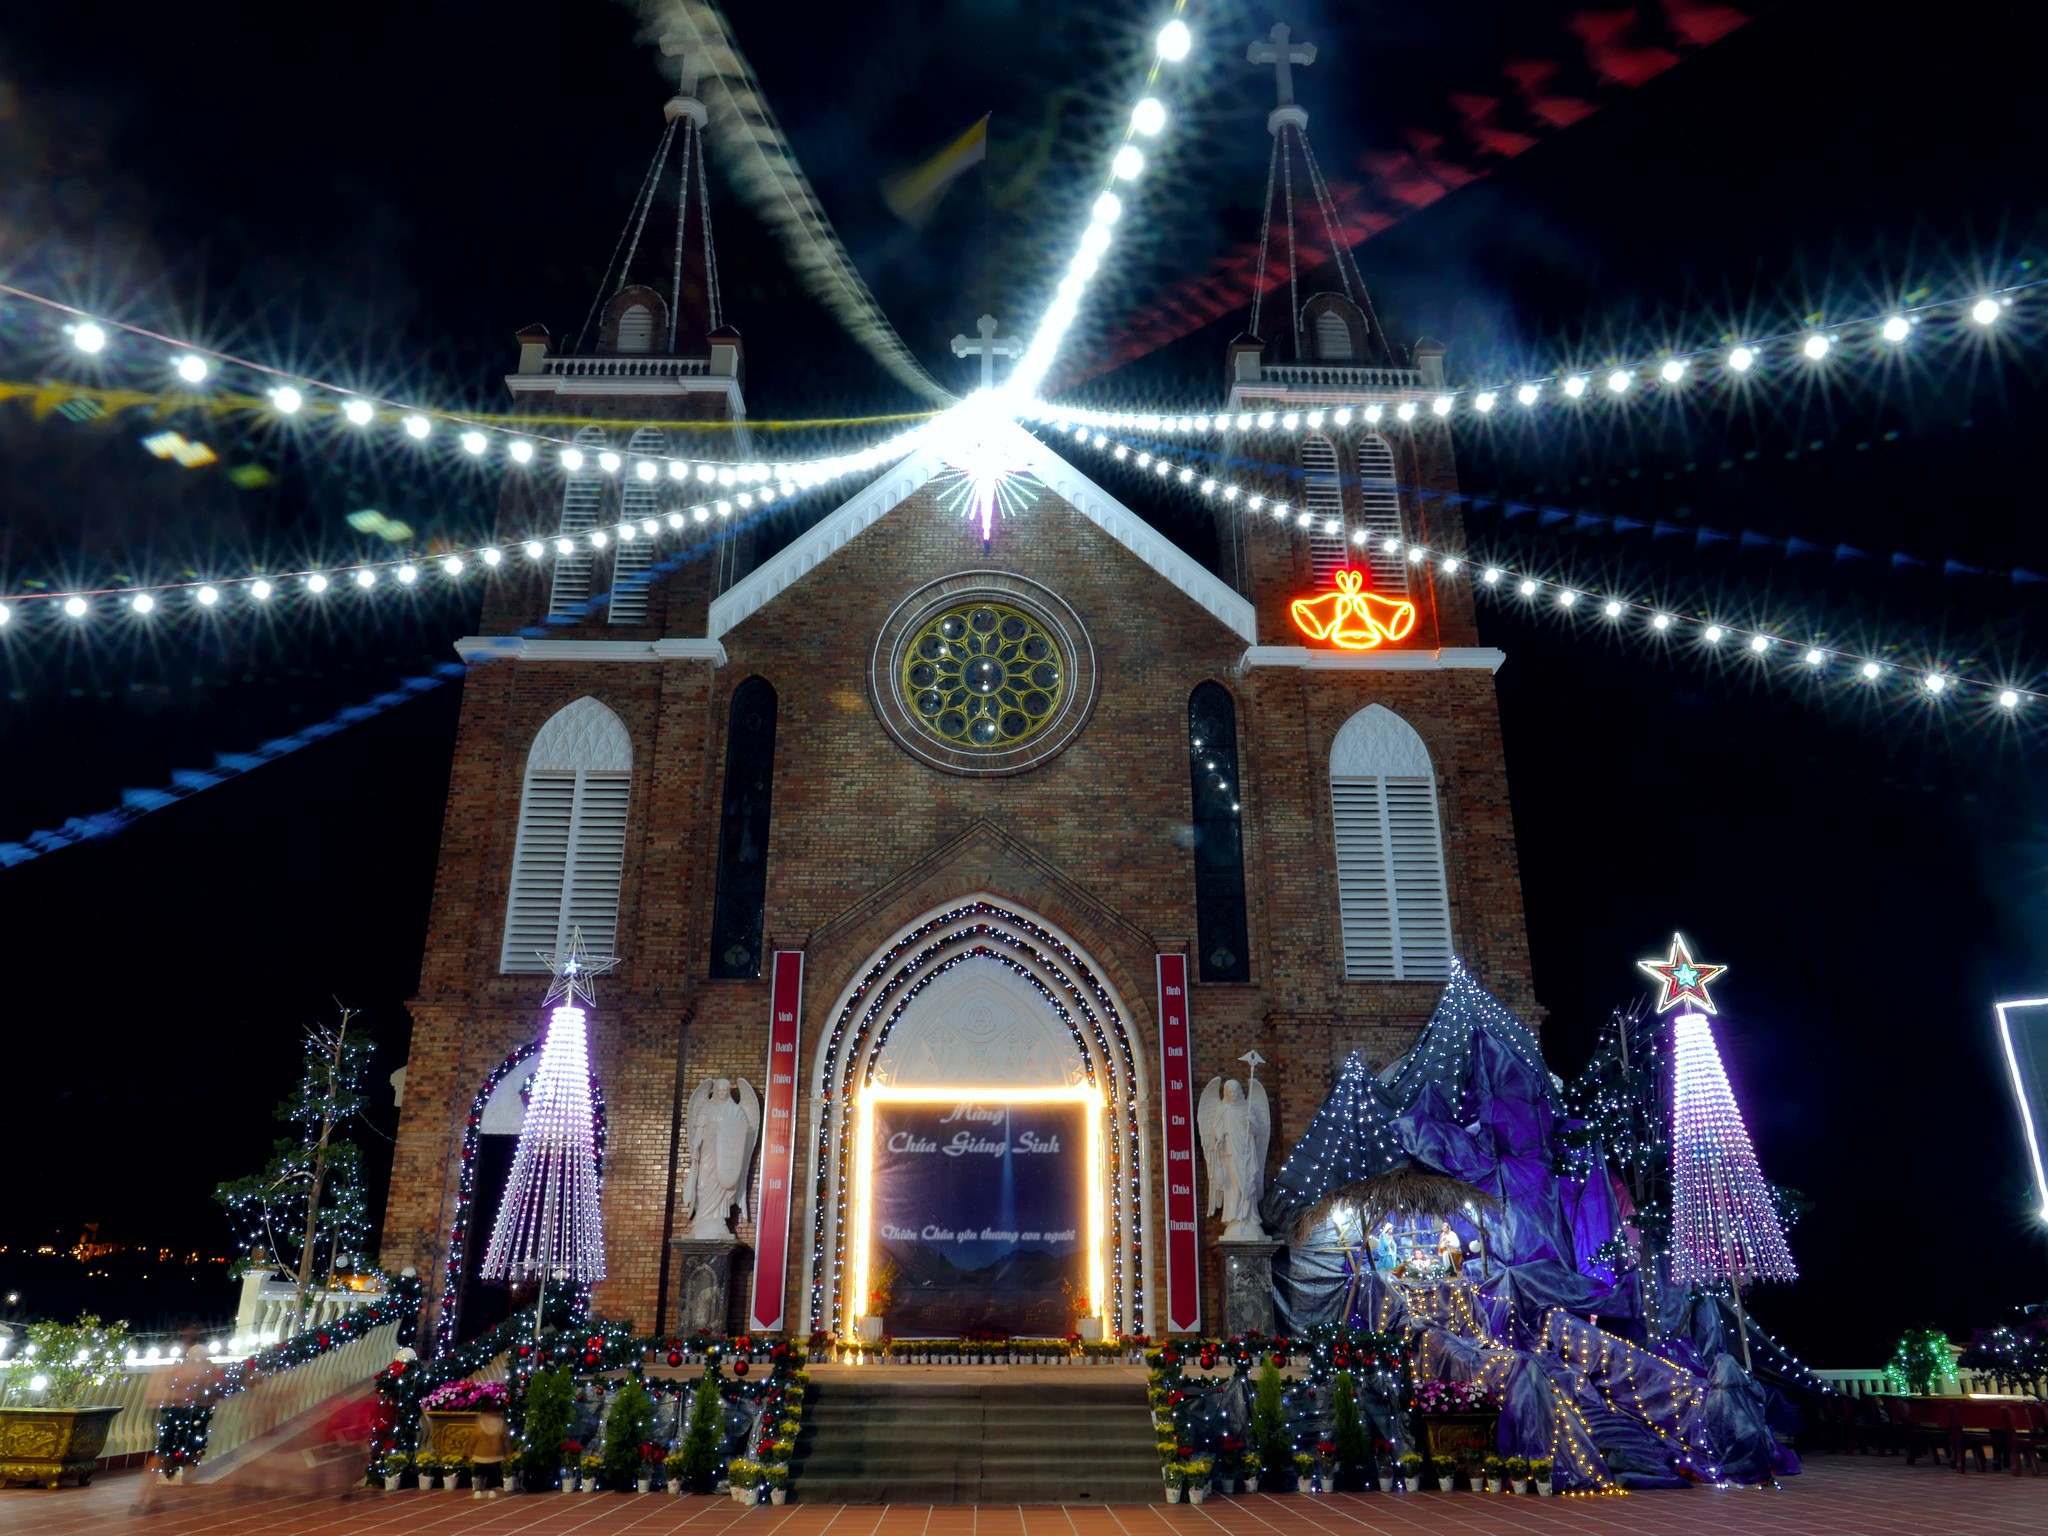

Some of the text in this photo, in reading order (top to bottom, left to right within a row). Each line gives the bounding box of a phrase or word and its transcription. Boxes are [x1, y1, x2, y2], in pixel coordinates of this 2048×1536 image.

[1172, 1115, 1185, 1125] Cho
[888, 1131, 1060, 1158] Chúa Giáng Sinh
[881, 1224, 917, 1240] Thiên
[922, 1225, 955, 1241] Chúa
[957, 1229, 978, 1243] yêu
[1021, 1232, 1041, 1241] con
